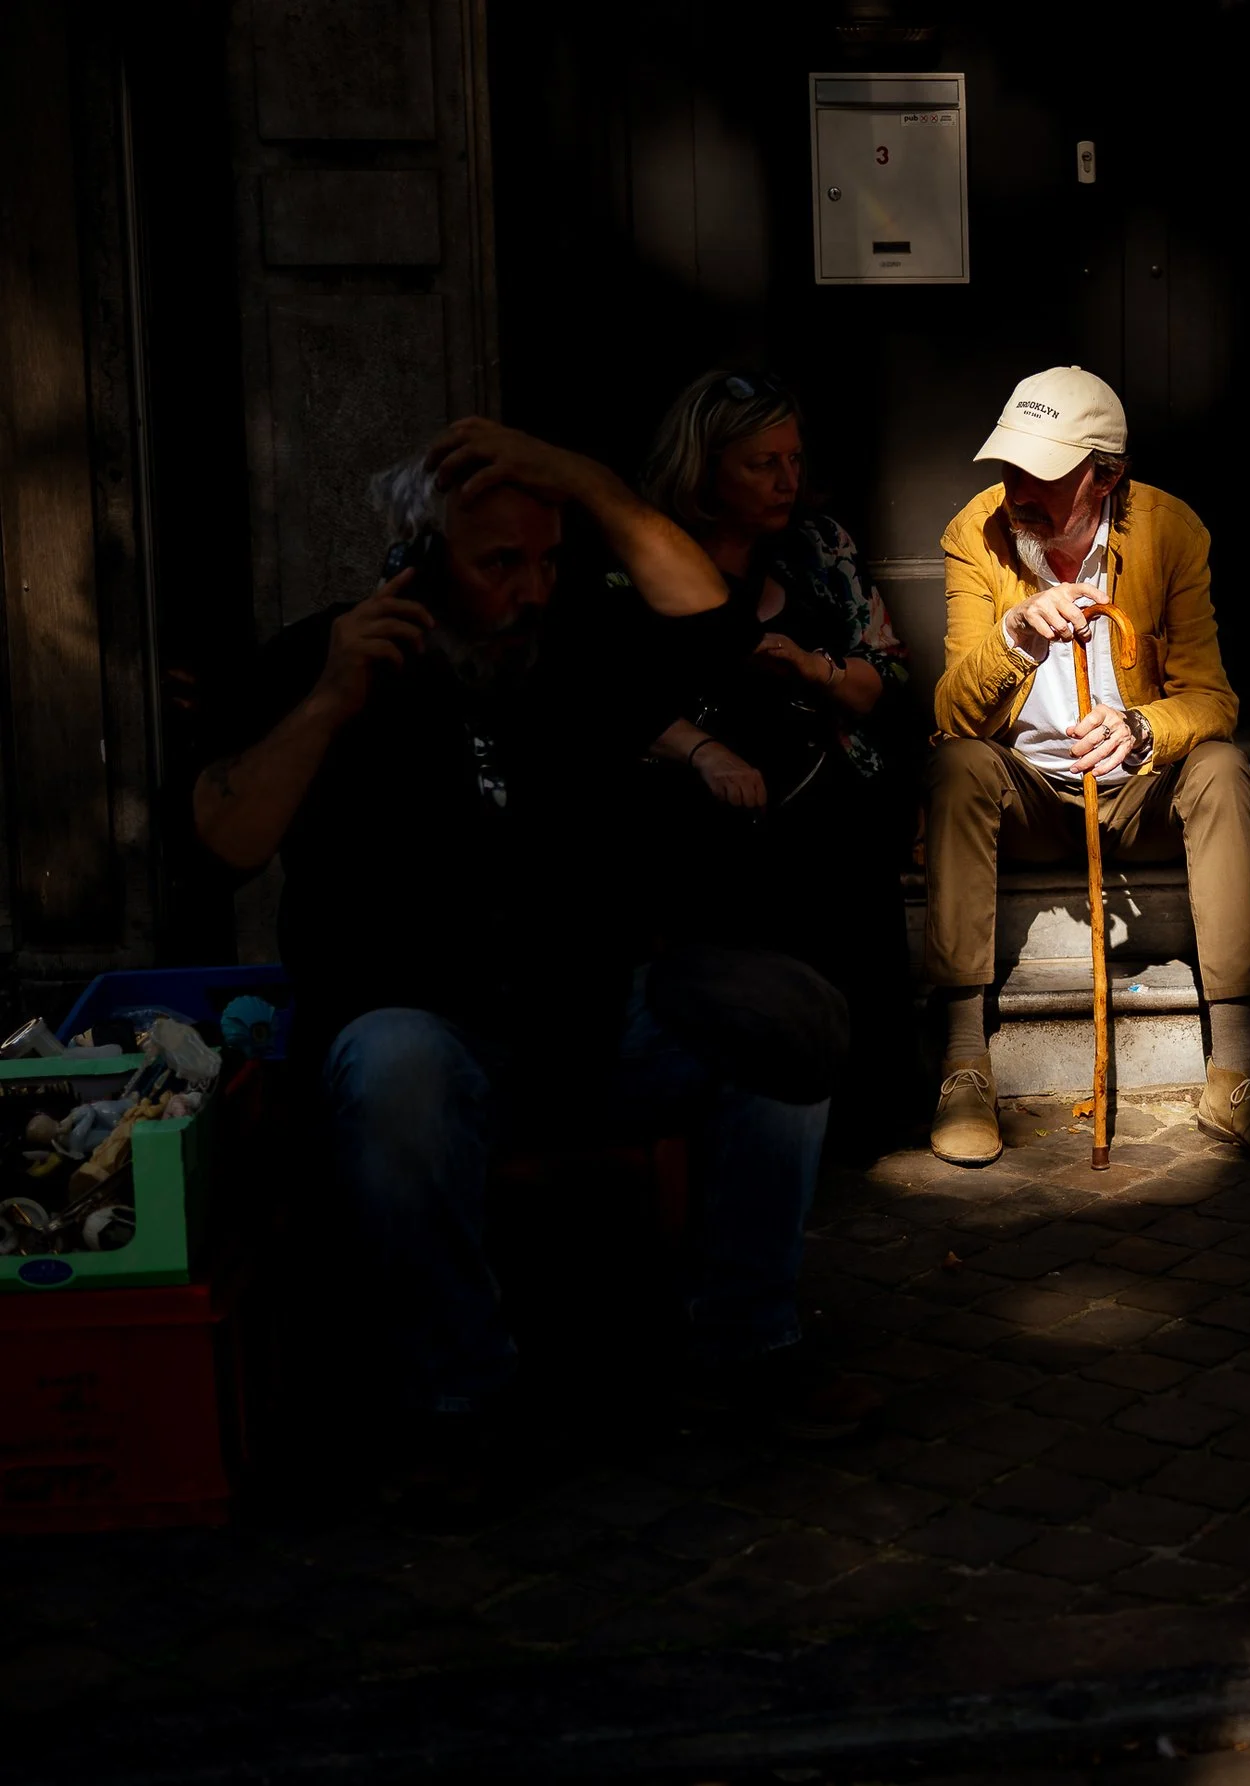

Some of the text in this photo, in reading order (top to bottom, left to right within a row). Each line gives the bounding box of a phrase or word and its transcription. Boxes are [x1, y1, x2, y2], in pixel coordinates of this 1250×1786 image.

[904, 114, 919, 123] pub
[876, 146, 889, 165] 3
[1015, 400, 1060, 420] BROOKLYN
